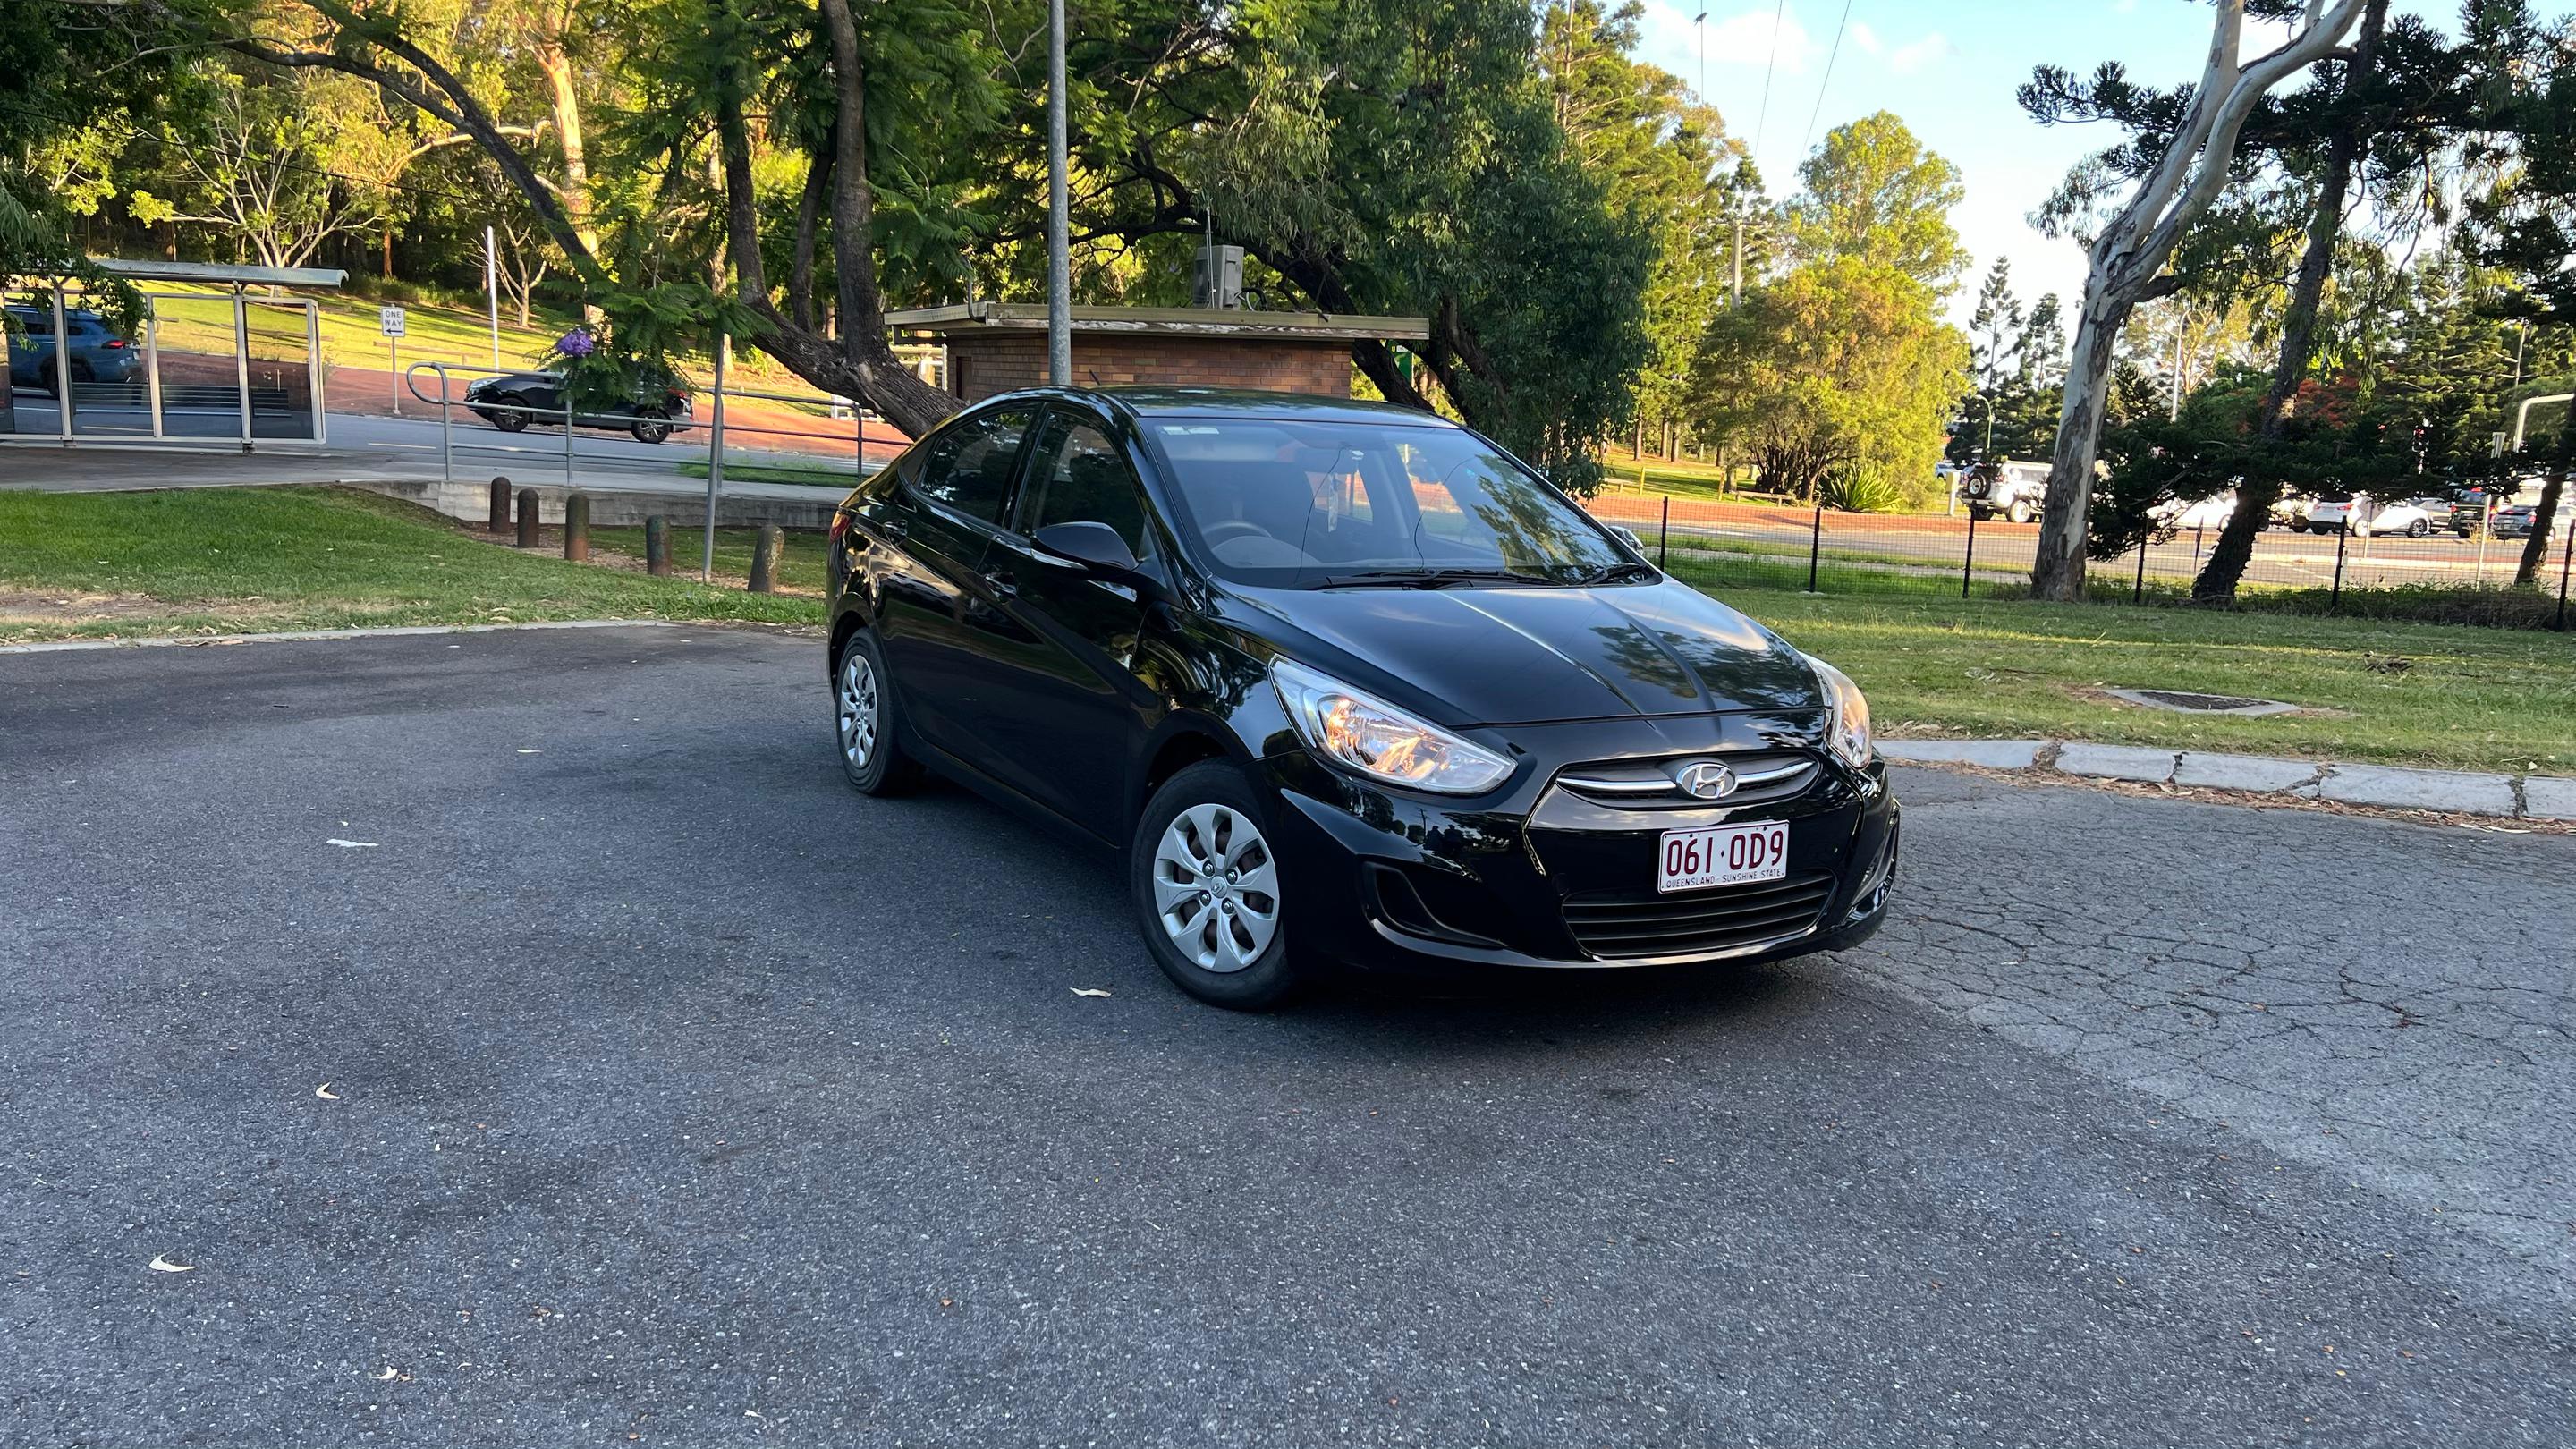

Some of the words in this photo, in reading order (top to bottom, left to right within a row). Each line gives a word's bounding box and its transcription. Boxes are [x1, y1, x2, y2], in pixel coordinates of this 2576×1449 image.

[385, 310, 402, 318] ONE
[385, 319, 402, 327] WAY
[1665, 876, 1716, 888] QUEENSLAND
[1723, 871, 1758, 883] SUNSHINE
[1760, 868, 1781, 878] STATE
